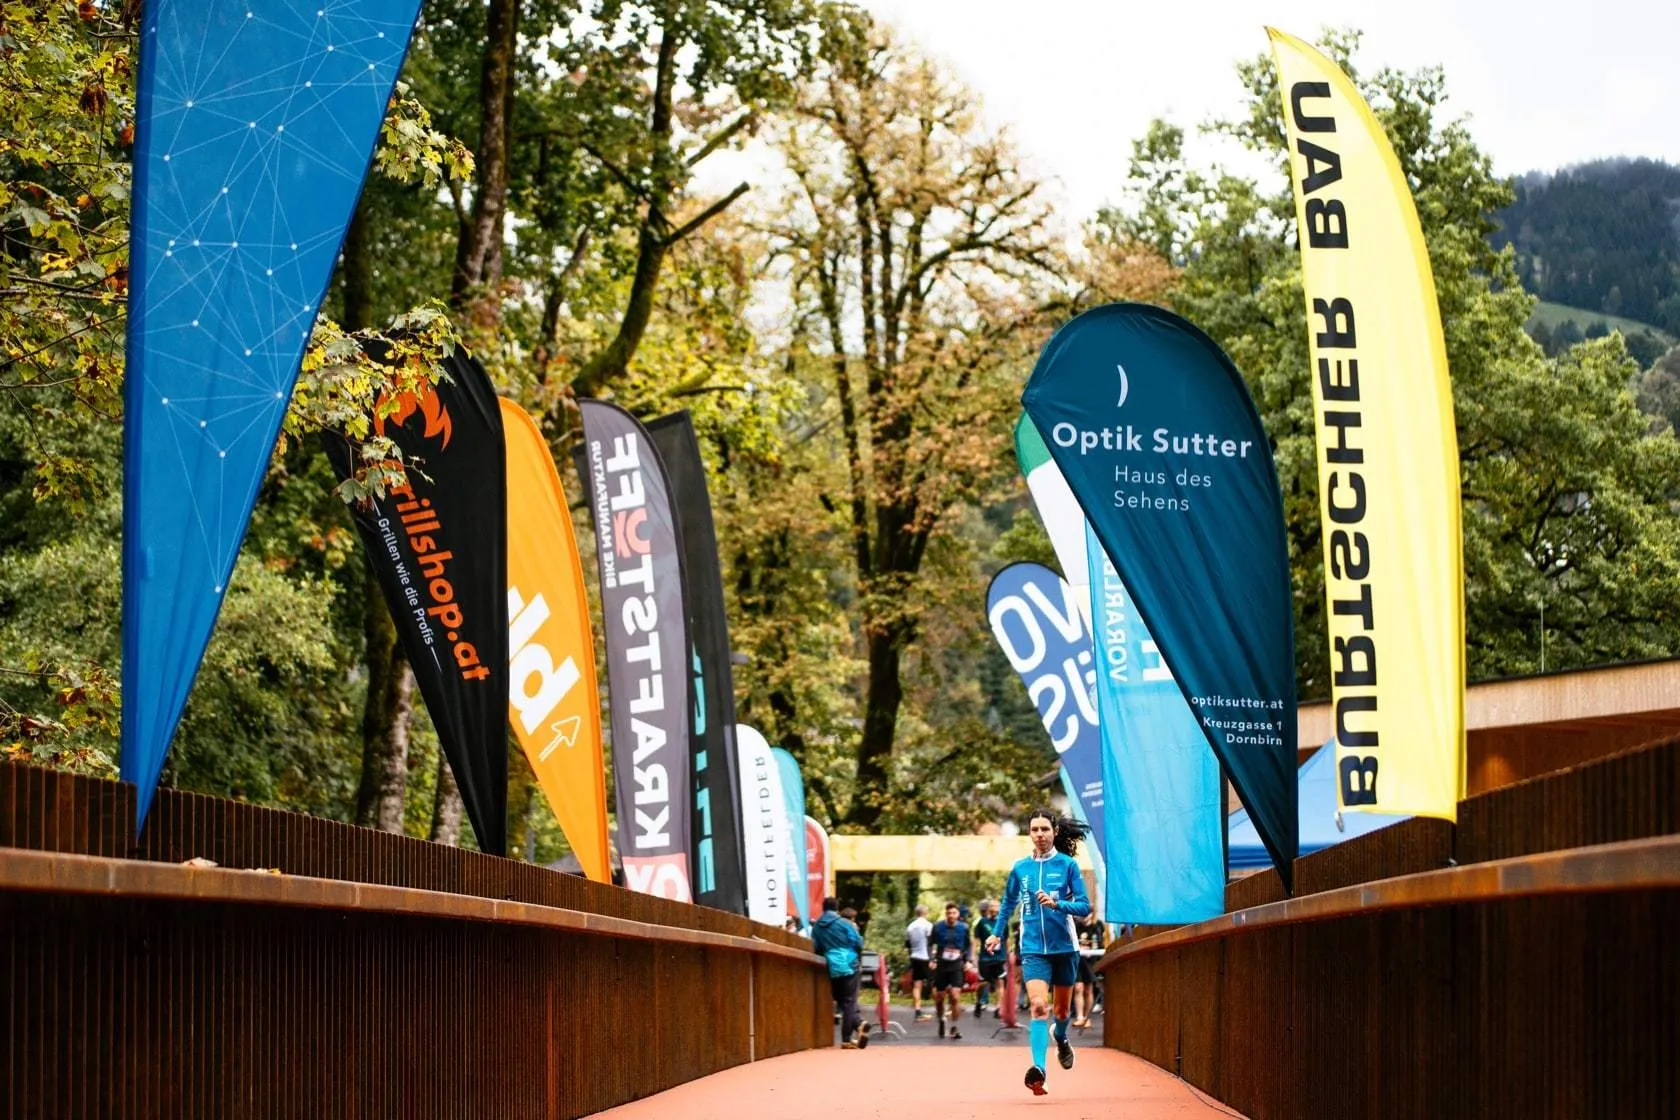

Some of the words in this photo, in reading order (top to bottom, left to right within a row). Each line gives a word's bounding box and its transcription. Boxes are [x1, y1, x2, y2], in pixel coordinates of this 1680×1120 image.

[1052, 422, 1142, 455] Optik
[1153, 428, 1252, 459] Sutter
[1114, 465, 1166, 485] Haus
[1175, 468, 1212, 487] des
[1113, 490, 1189, 511] Sehens
[378, 518, 402, 561] Grillen
[395, 562, 411, 586] wie
[404, 587, 419, 607] die
[412, 607, 434, 646] Profis
[1191, 695, 1284, 711] optiksutter.at
[1202, 716, 1273, 733] Kreuzgasse
[1276, 721, 1283, 731] 1
[1225, 733, 1283, 746] Dornbirn
